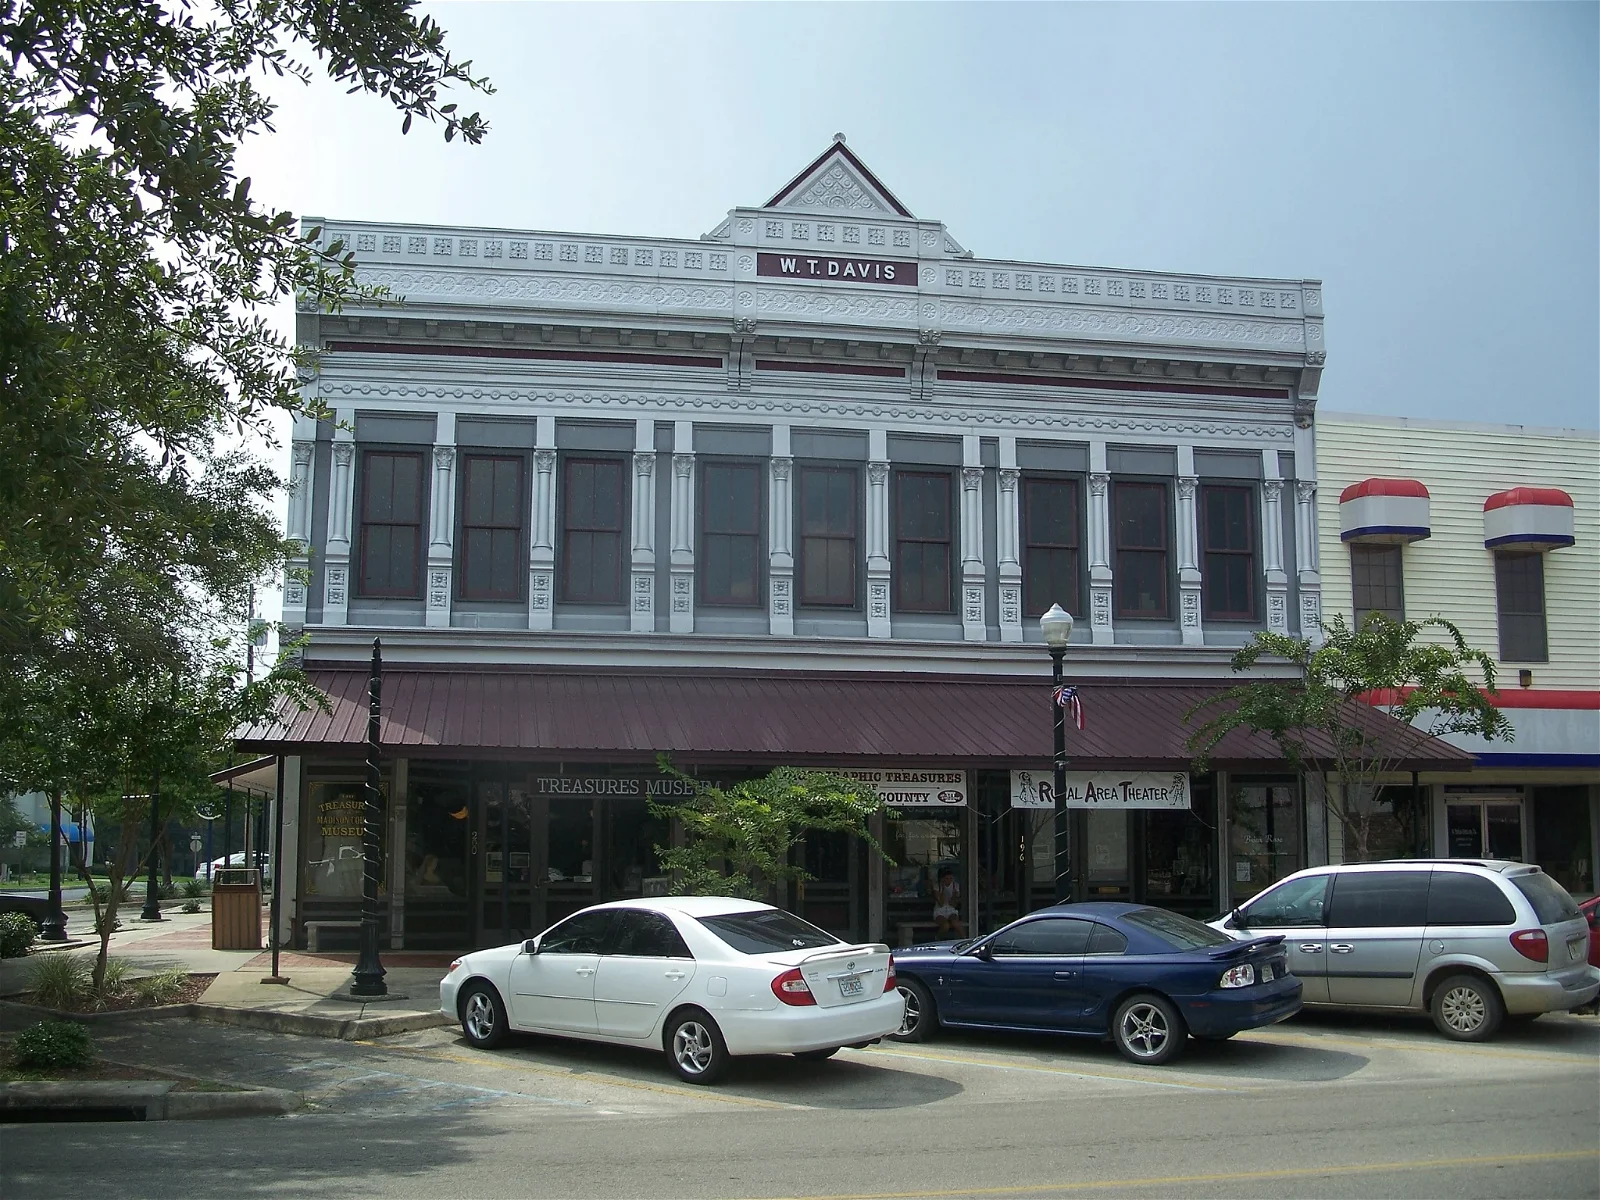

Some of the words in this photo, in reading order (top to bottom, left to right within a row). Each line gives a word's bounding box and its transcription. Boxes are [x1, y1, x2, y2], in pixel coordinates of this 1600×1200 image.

[780, 257, 801, 274] W.
[806, 259, 821, 275] T.
[827, 261, 896, 280] DAVIS
[885, 771, 962, 784] TREASURES
[537, 777, 640, 794] TREASURES
[878, 792, 930, 803] COUNTY
[1084, 781, 1119, 803] AREA
[1118, 781, 1169, 803] THEATER
[316, 815, 349, 825] MADISON
[321, 827, 364, 837] MUSEU
[1264, 834, 1283, 843] Rose
